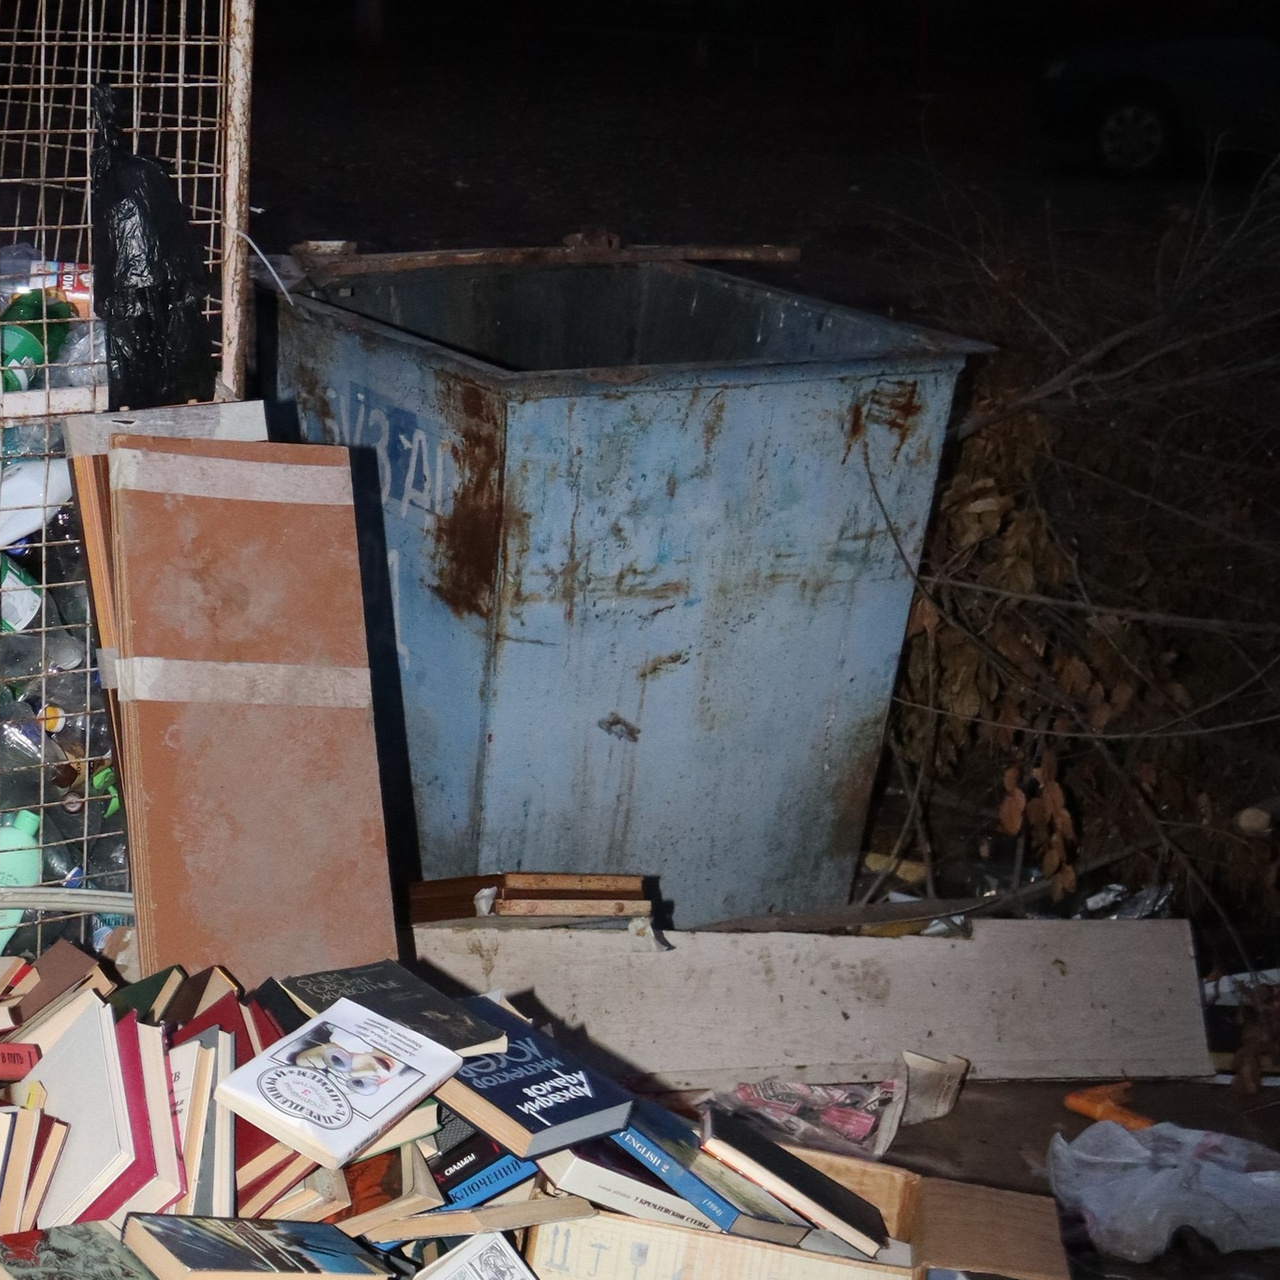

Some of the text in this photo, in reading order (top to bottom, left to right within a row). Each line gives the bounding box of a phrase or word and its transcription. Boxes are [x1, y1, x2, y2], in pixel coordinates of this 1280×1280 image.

[0, 1052, 6, 1063] В
[7, 1052, 23, 1063] ПУТЬ
[265, 1070, 346, 1124] ЗАПРЕЩЕННЫЙ
[297, 1070, 342, 1102] ПРИЕМ
[516, 1068, 594, 1127] Аркадий
[444, 1153, 476, 1177] СВАДЬБЫ
[623, 1131, 662, 1166] ENGLISH
